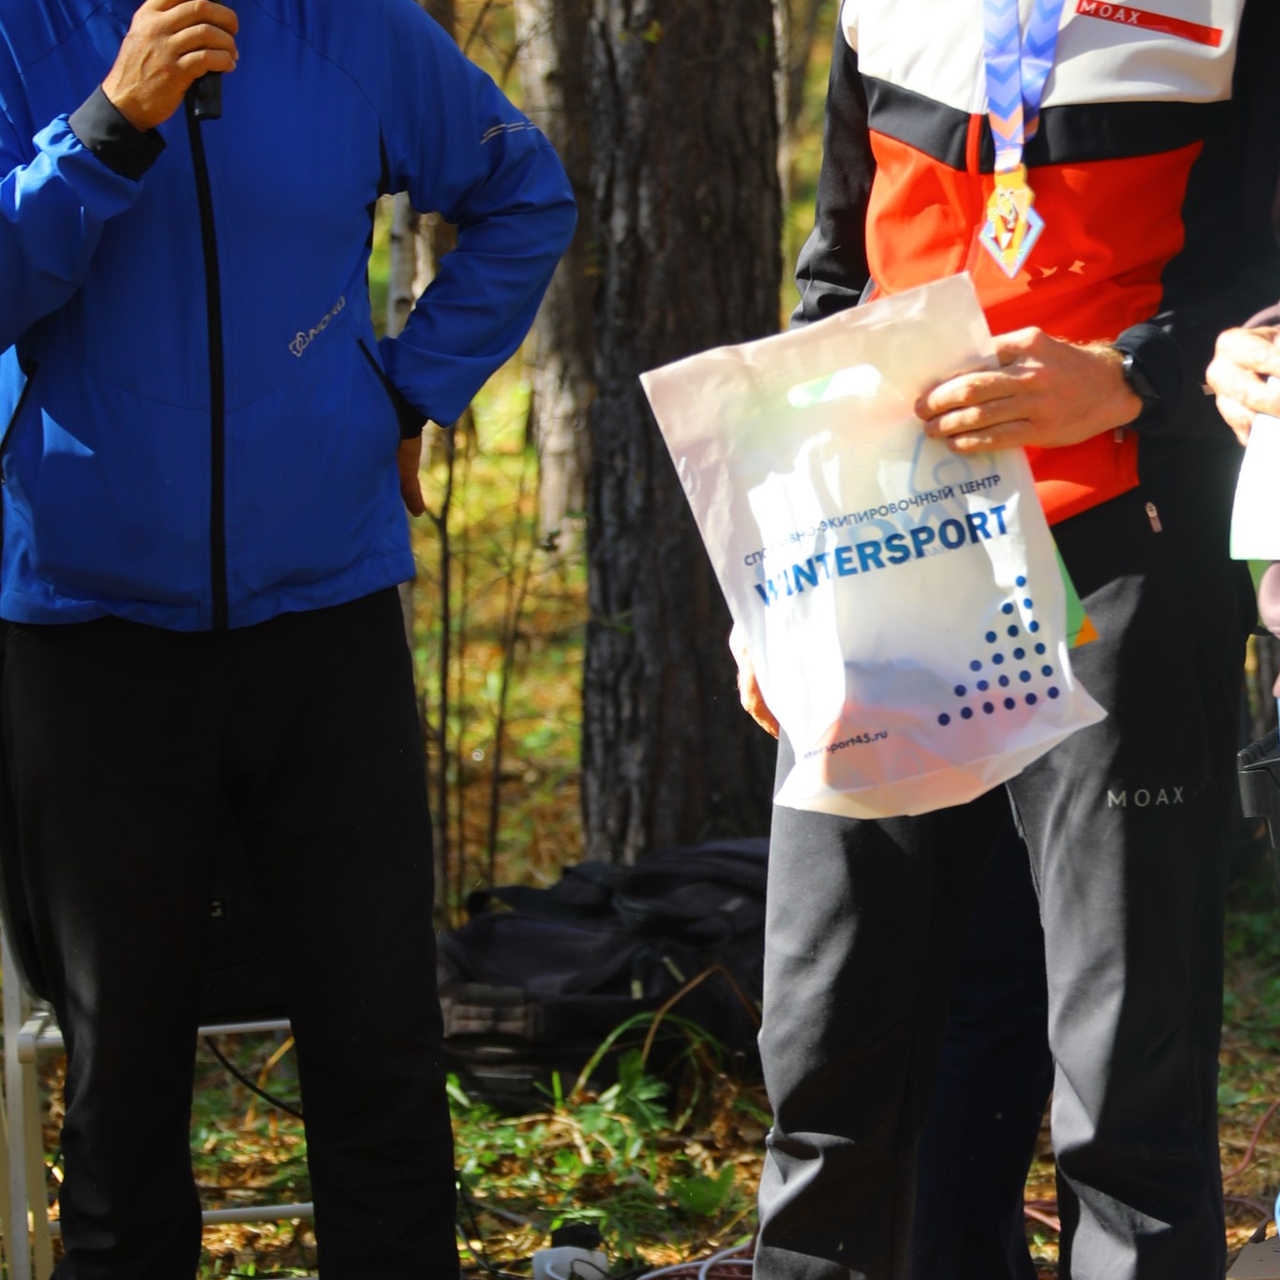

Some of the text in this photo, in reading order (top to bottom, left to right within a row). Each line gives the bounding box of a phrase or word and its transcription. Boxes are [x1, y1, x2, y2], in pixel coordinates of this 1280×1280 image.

[1079, 0, 1141, 24] MOAX
[959, 474, 1001, 496] ЦЕНТР
[1107, 786, 1184, 808] MOAX
